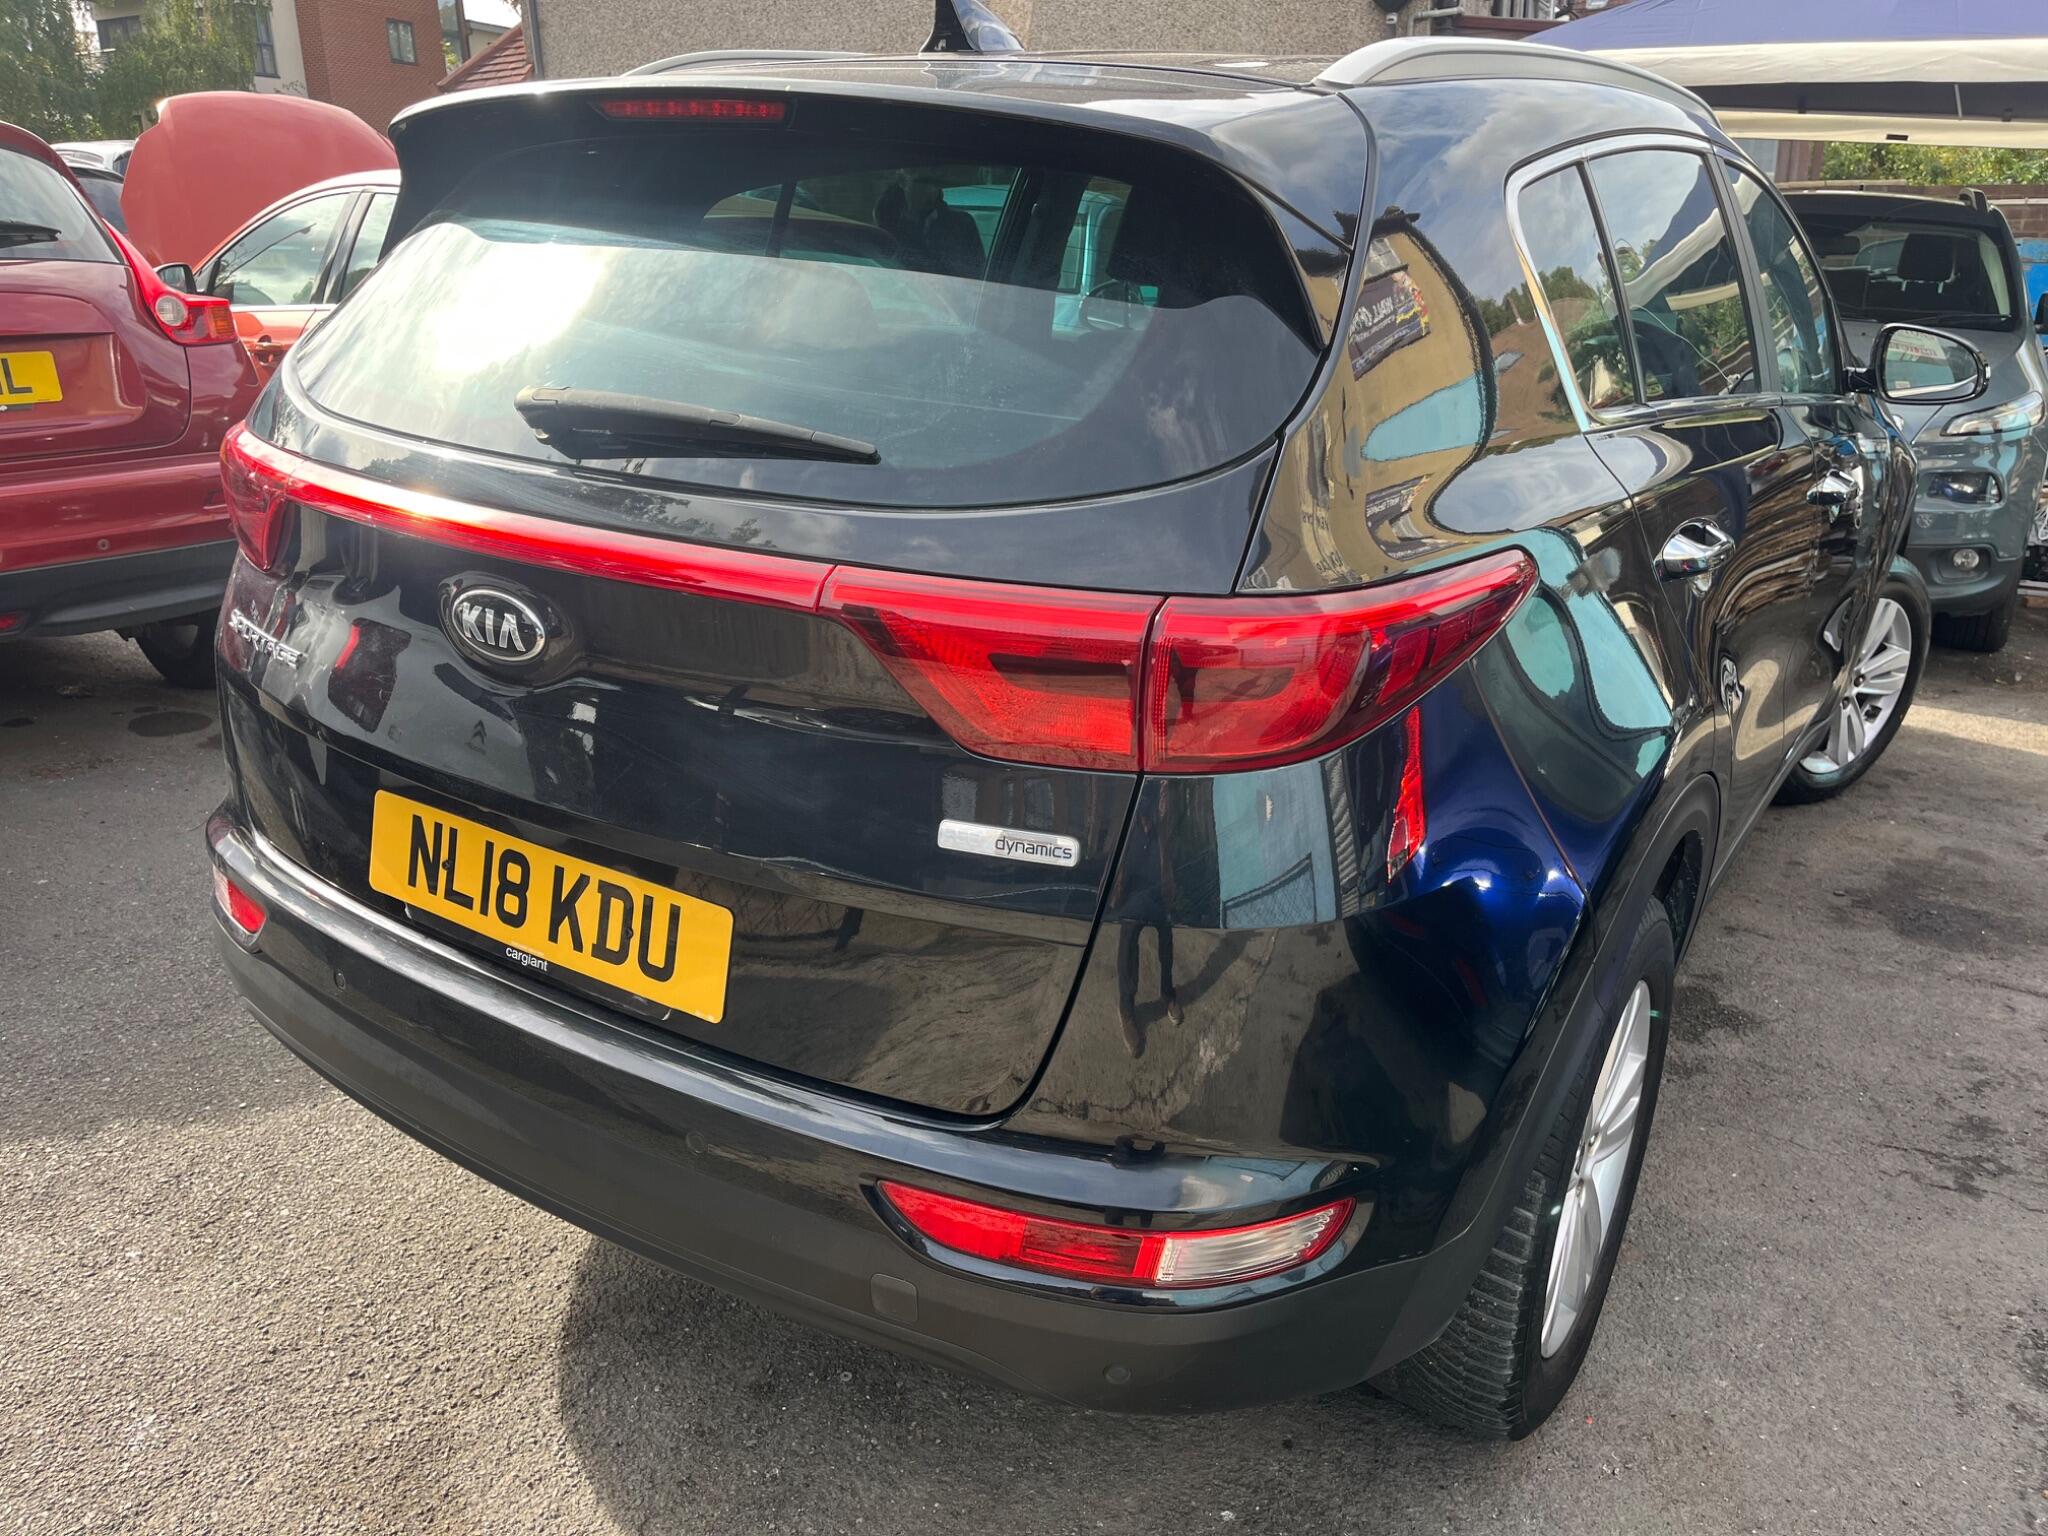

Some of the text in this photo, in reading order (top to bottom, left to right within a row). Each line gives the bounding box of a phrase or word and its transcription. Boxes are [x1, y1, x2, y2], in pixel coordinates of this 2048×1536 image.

[0, 358, 33, 395] L
[461, 602, 526, 651] KIA
[995, 835, 1072, 859] dynamics
[408, 814, 681, 982] NL18 KDU
[505, 946, 548, 972] cargiant
